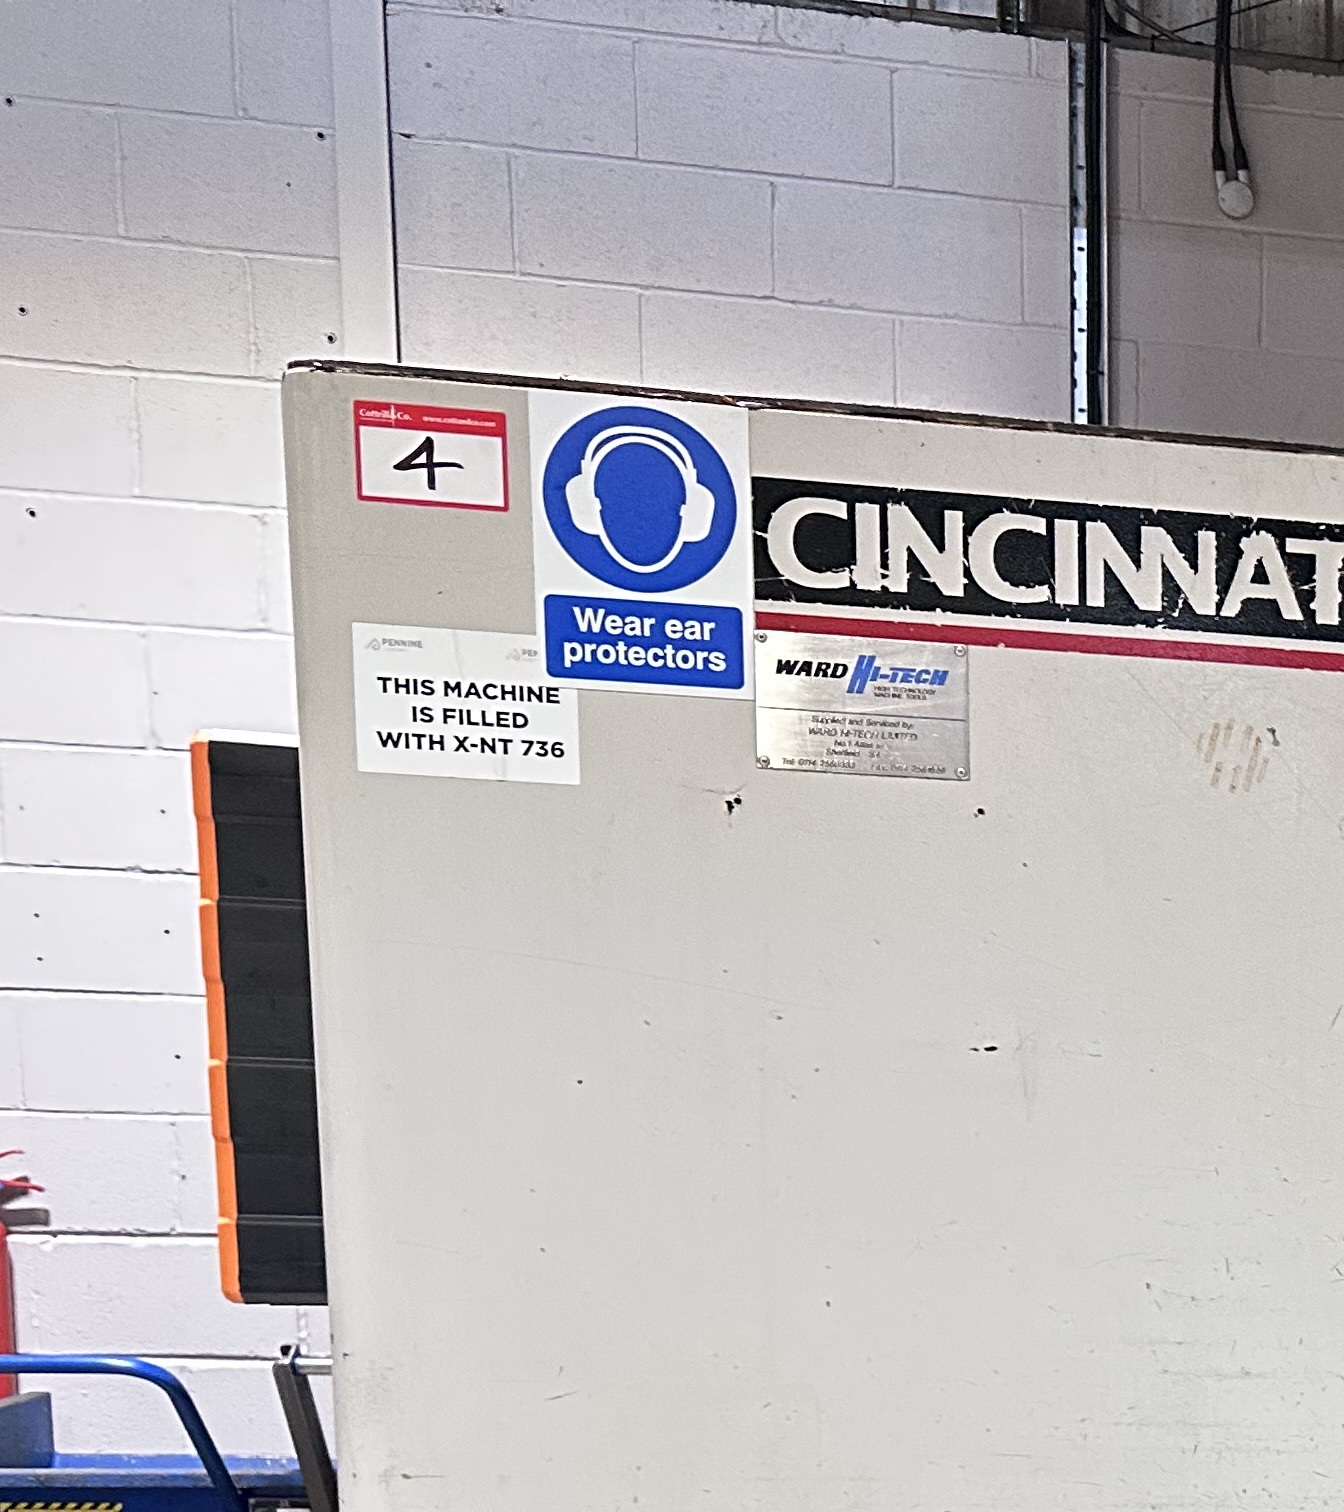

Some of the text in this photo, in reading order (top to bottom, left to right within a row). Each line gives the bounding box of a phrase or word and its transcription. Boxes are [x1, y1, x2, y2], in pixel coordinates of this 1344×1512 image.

[393, 436, 464, 490] 4
[572, 606, 716, 641] Wear ear
[563, 641, 727, 672] protectors
[377, 676, 561, 704] THIS MACHINE
[776, 655, 949, 694] WARD HI-TECH
[412, 706, 529, 729] IS FILLED
[376, 731, 565, 758] WITH X-NT 736
